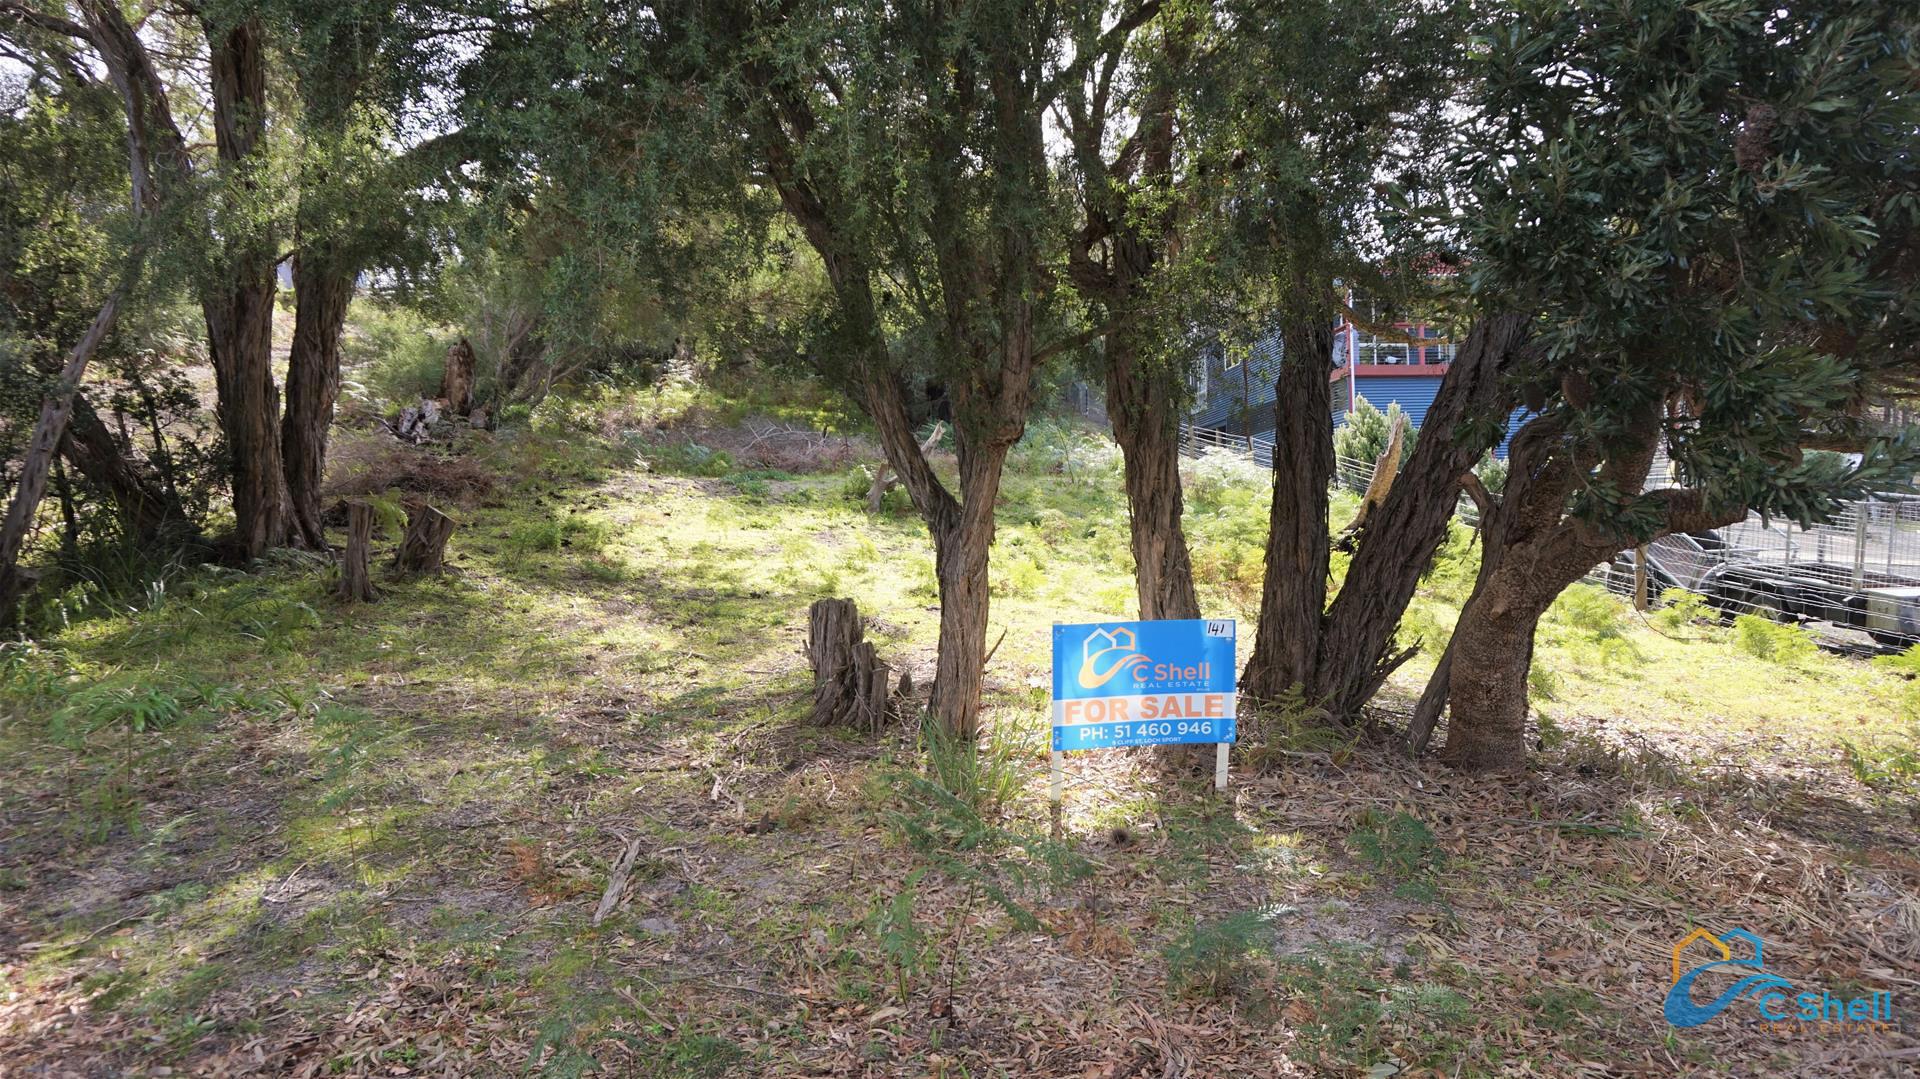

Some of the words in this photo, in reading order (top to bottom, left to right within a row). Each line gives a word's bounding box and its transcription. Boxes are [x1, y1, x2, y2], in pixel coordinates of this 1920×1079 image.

[1207, 622, 1225, 636] 141
[1132, 664, 1149, 682] C
[1154, 661, 1210, 681] Shell
[1167, 680, 1210, 688] ESTATE
[1064, 698, 1130, 725] FOR
[1140, 694, 1224, 719] SALE
[1079, 727, 1108, 741] PH:
[1114, 724, 1131, 738] 51
[1136, 723, 1172, 737] 460
[1177, 721, 1212, 735] 946
